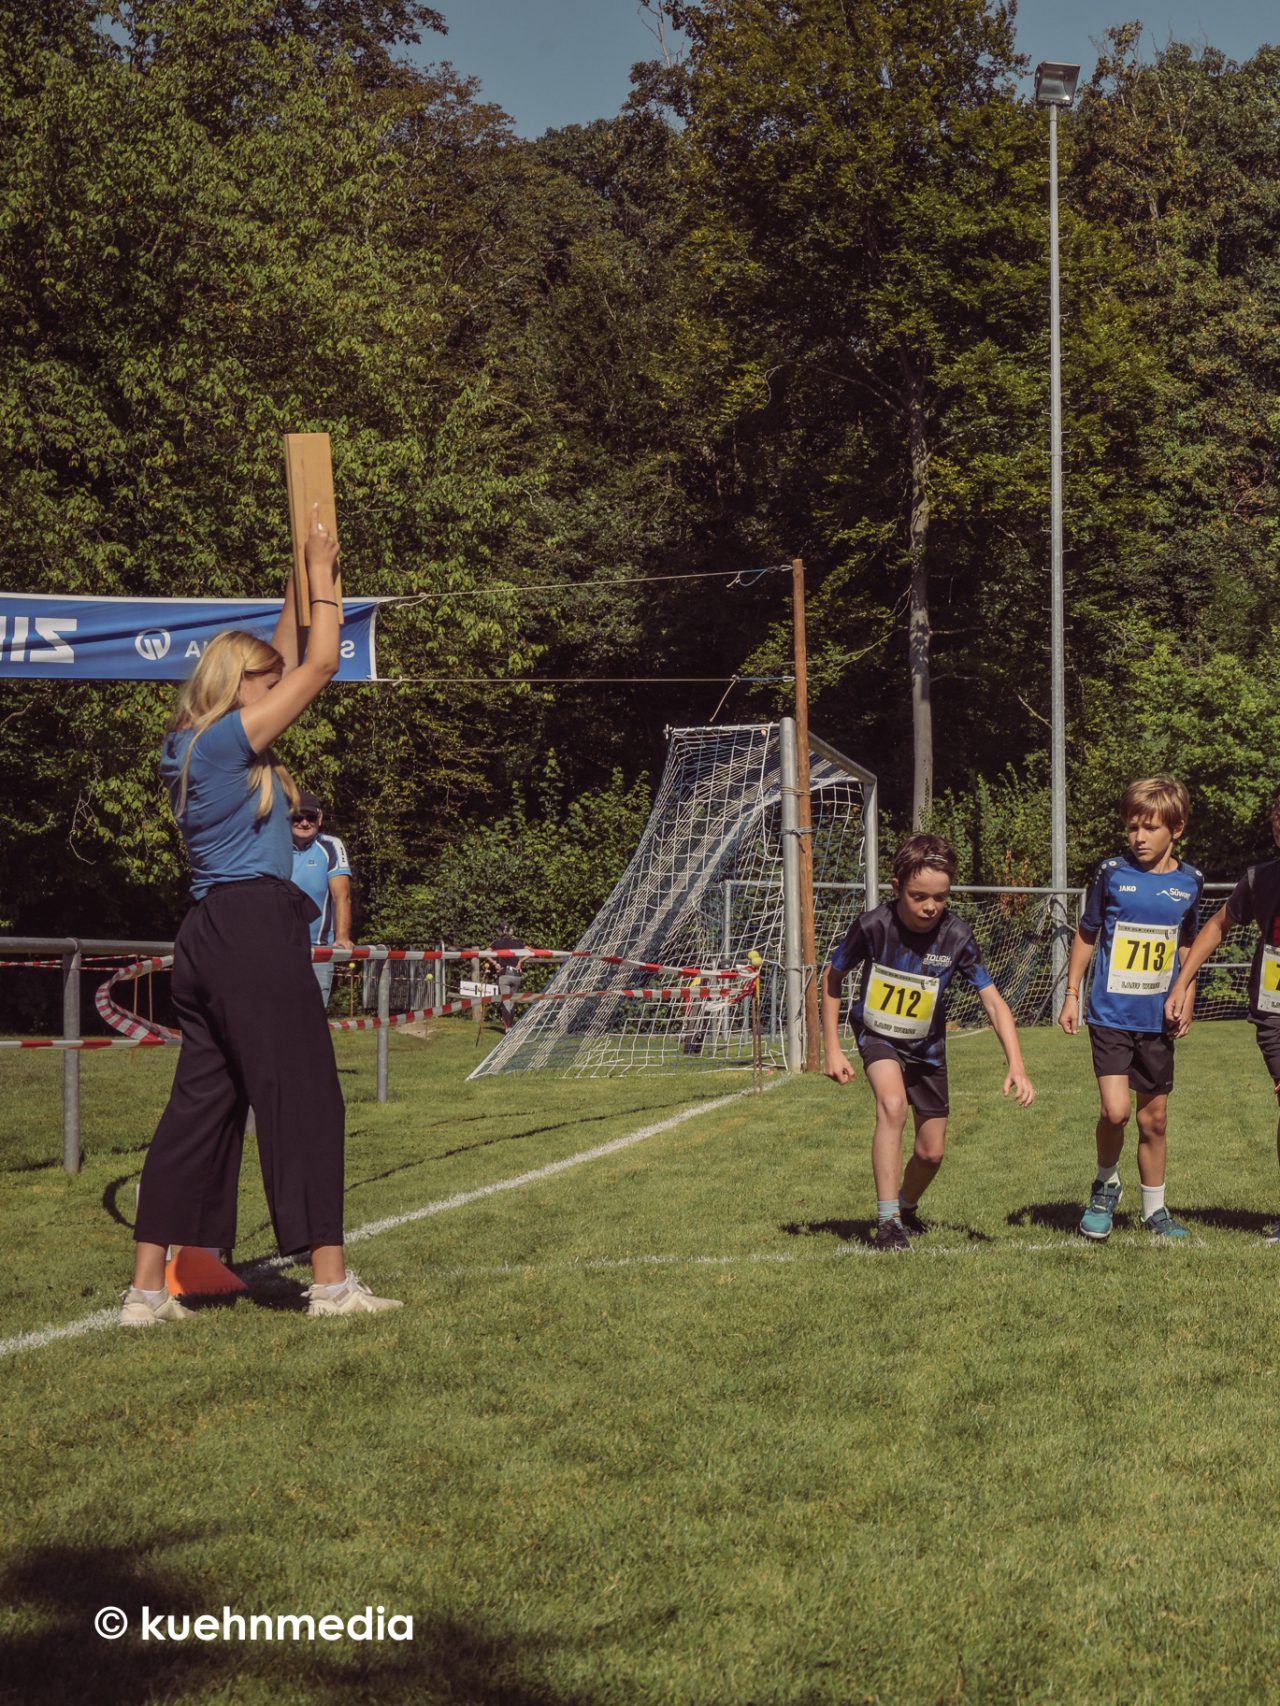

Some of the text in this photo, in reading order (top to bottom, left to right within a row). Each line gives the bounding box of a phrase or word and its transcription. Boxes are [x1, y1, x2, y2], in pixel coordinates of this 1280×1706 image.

[1118, 885, 1137, 893] JAKO
[1126, 940, 1166, 972] 713
[880, 983, 921, 1018] 712
